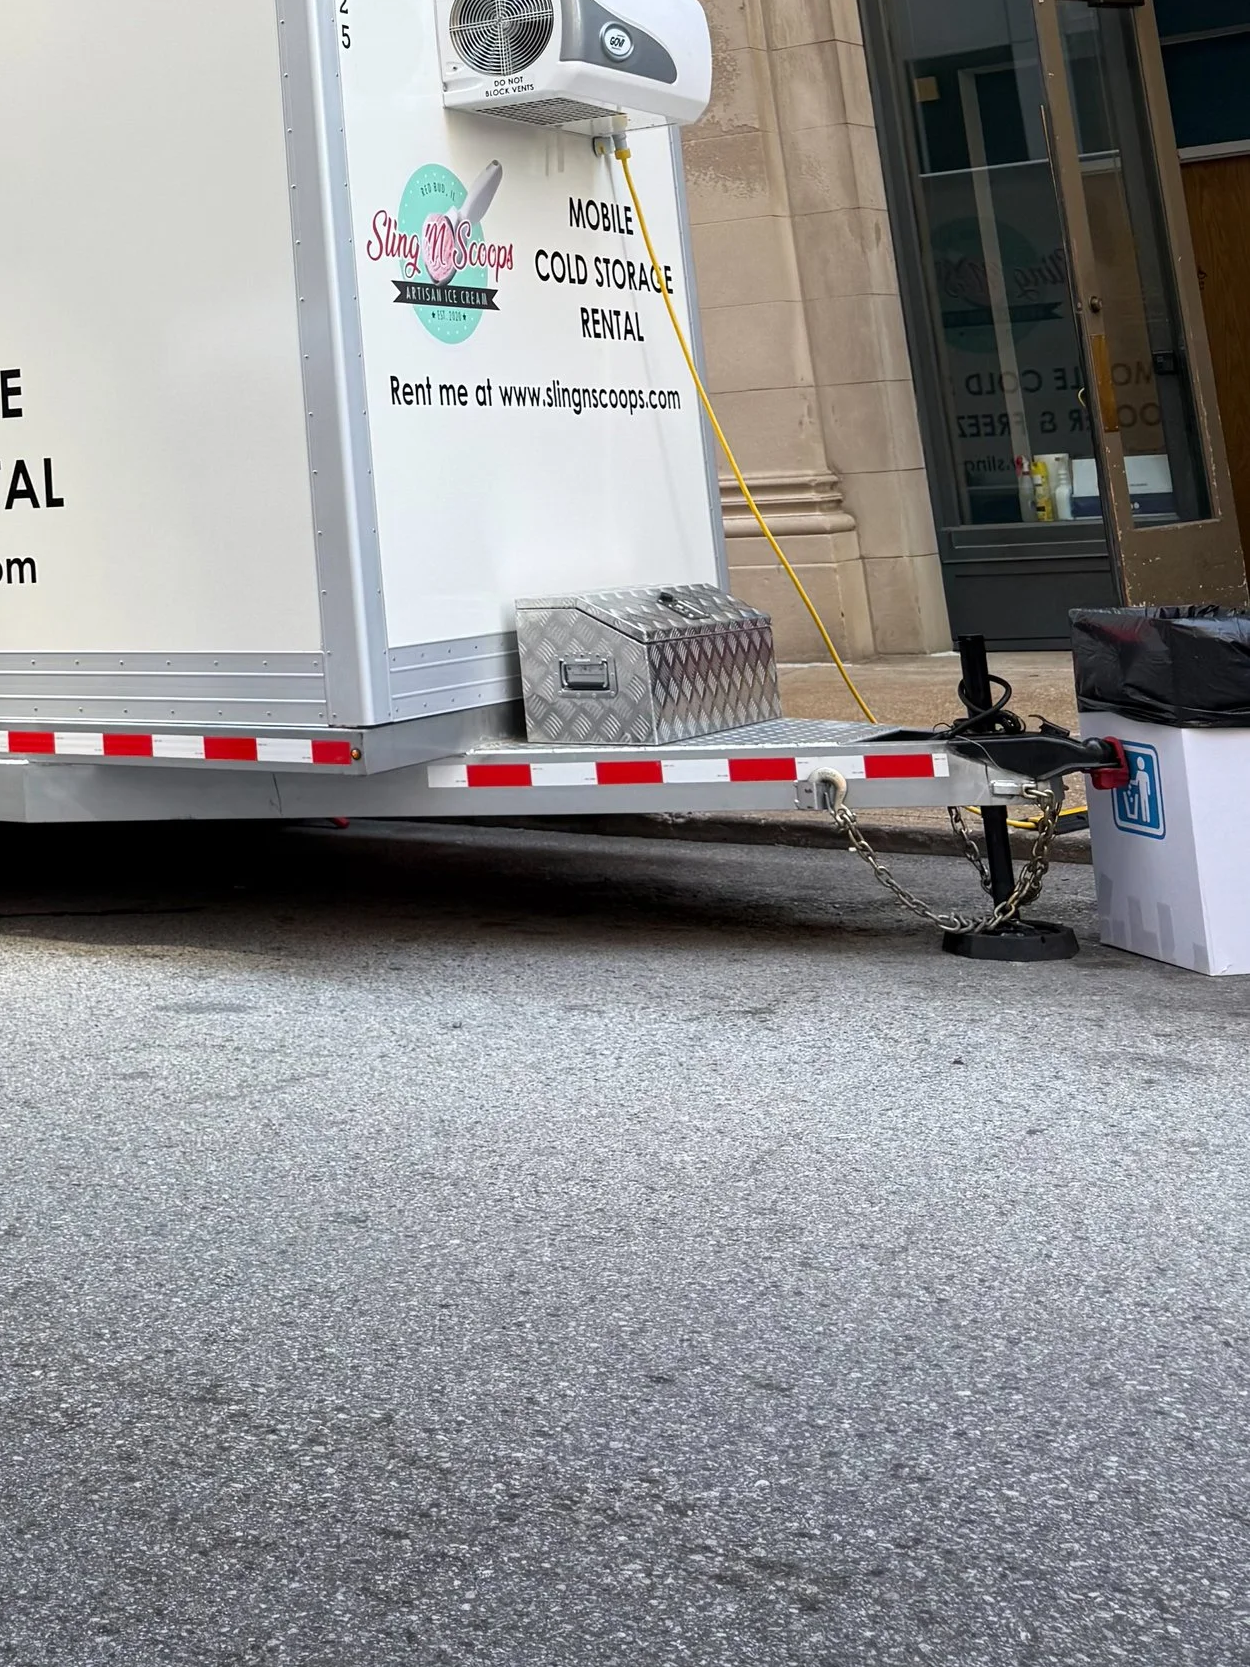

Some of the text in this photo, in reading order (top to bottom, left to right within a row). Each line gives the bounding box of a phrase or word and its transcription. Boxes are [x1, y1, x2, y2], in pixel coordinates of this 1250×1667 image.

[485, 83, 535, 98] BLOCK VENTS
[493, 76, 523, 87] DO NOT
[420, 182, 432, 197] RED
[568, 196, 634, 236] MOBILE
[366, 209, 422, 279] Sling
[452, 220, 514, 283] Scoops
[535, 248, 588, 285] COLD
[406, 285, 488, 306] ARTISAN ICE CREAM
[579, 306, 645, 342] RENTAL
[389, 375, 682, 415] Rent me at www.slingnscoops.com
